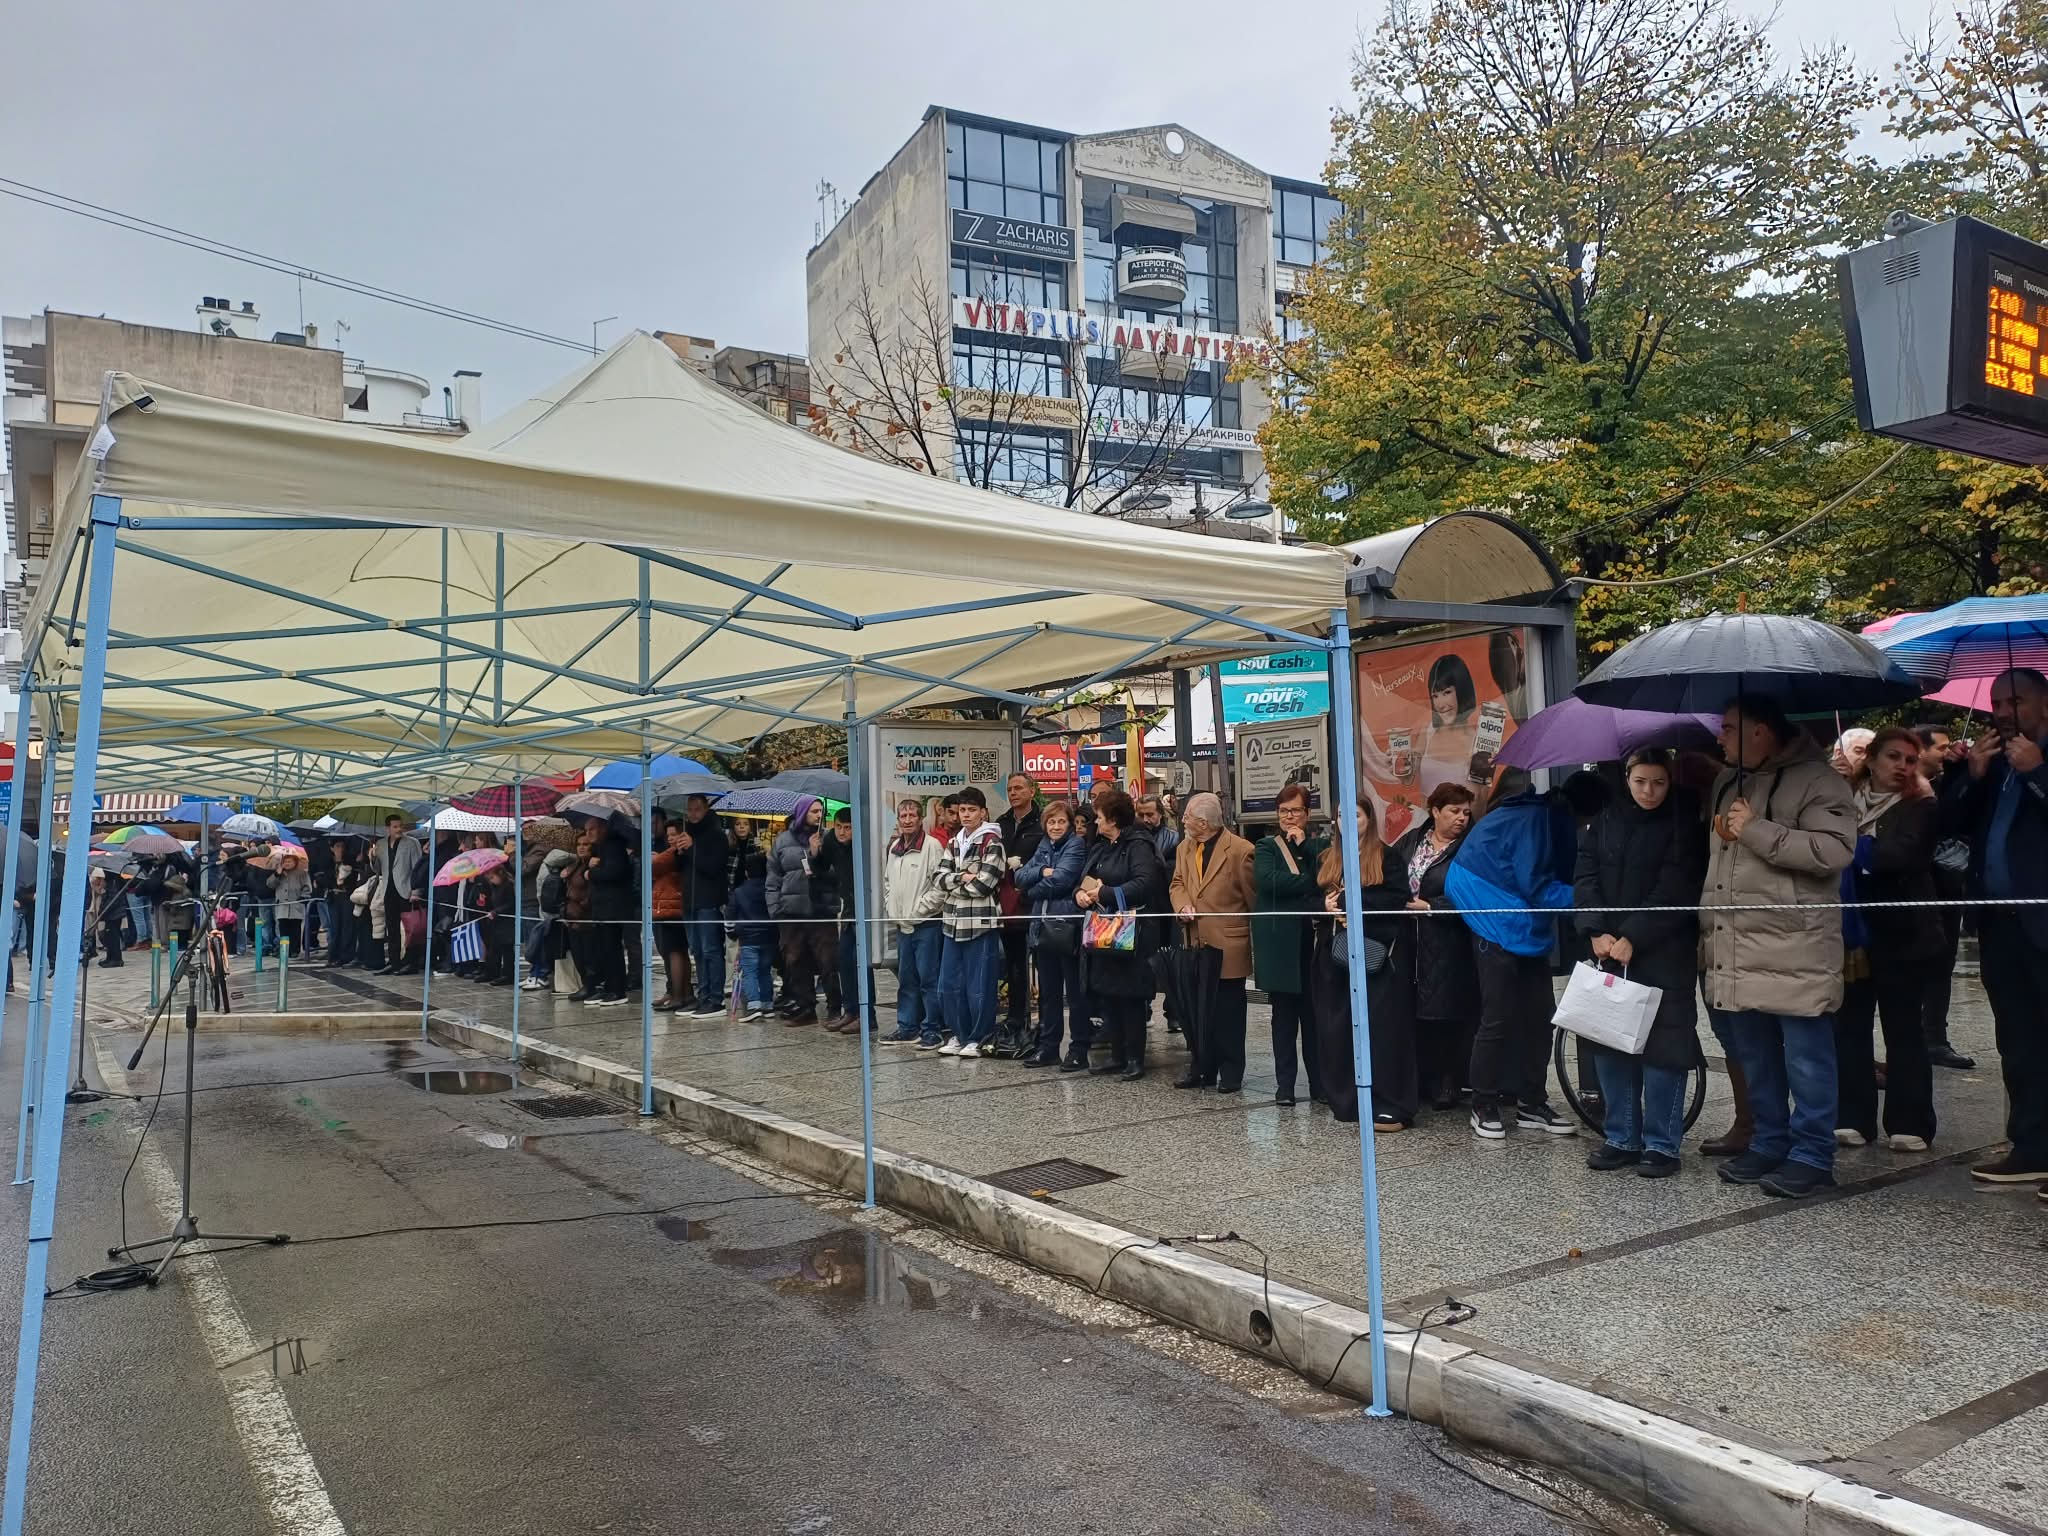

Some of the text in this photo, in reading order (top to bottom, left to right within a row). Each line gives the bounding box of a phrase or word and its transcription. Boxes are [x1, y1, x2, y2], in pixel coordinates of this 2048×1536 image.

[996, 220, 1069, 247] ZACHARIS
[996, 238, 1031, 249] architecture
[1035, 245, 1070, 256] construction
[1131, 260, 1165, 270] ΑΣΤΕΡΙΟΣ
[963, 295, 1099, 344] VITAPLUS
[1245, 687, 1294, 704] novi
[1254, 698, 1304, 714] cash
[1480, 720, 1503, 733] alpro
[896, 745, 956, 758] ΣΚΑΝΑΡΕ
[907, 775, 965, 786] ΚΛΗΡΩΣΗ
